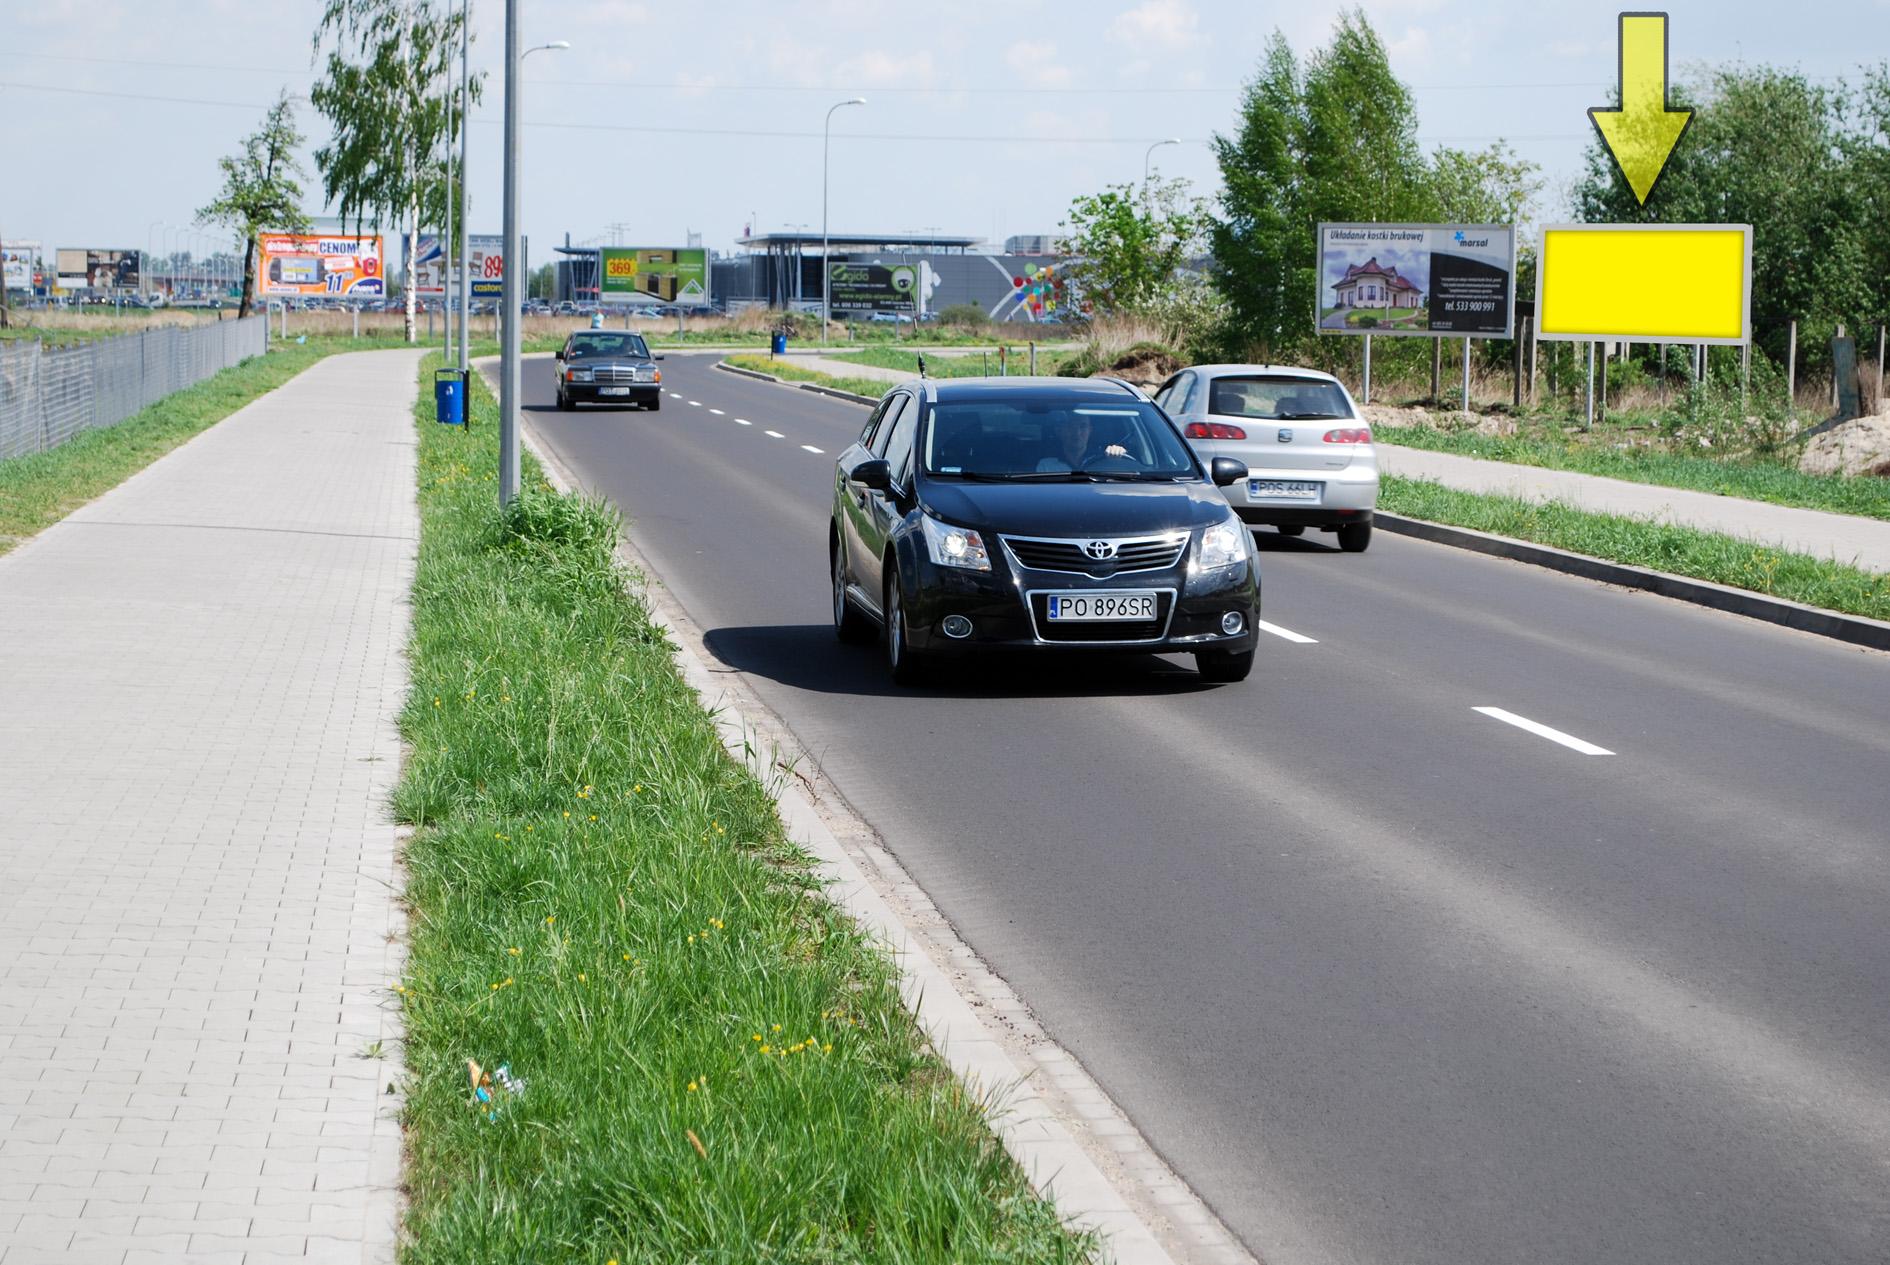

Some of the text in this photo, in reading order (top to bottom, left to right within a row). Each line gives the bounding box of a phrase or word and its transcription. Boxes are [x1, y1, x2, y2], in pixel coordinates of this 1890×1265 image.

[1330, 230, 1424, 243] Układanie kostki brukowej
[1459, 238, 1489, 247] marsal
[609, 262, 631, 275] 369
[1445, 301, 1495, 312] tel. 533 900 991
[1060, 598, 1152, 616] PO 896SR
